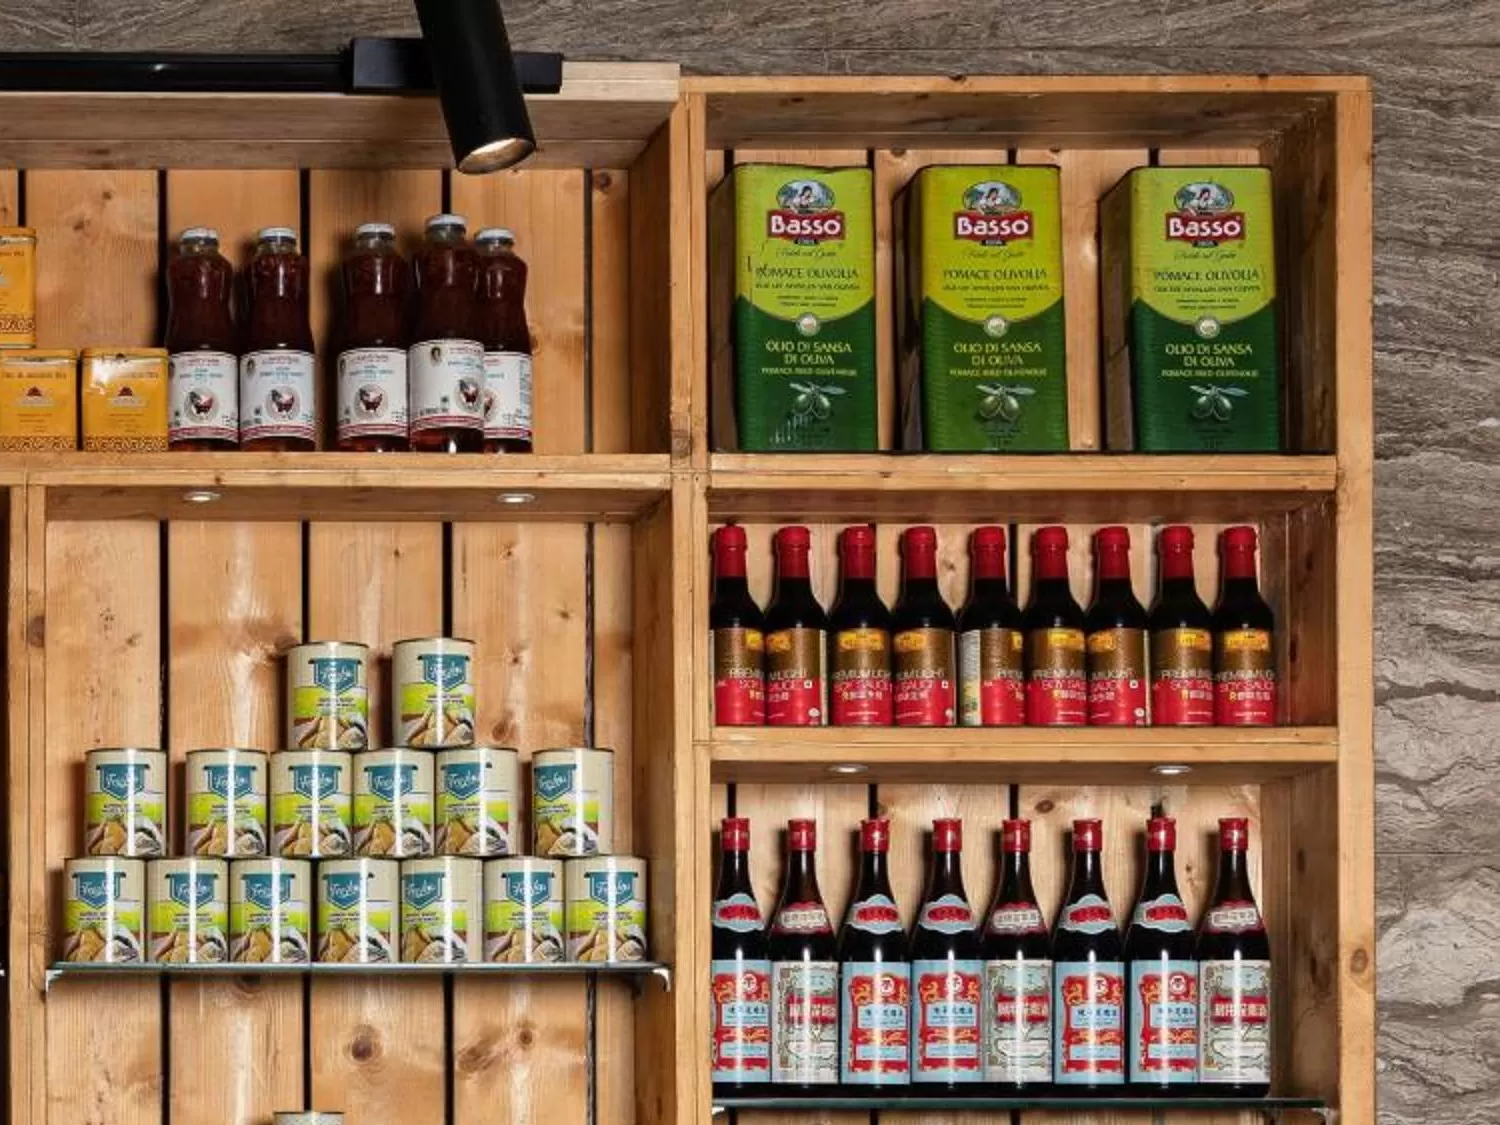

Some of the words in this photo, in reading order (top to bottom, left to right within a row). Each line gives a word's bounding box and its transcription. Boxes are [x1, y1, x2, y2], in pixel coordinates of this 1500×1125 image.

[771, 215, 841, 236] Basso
[956, 216, 1029, 236] Basso
[1169, 218, 1241, 237] Basso
[765, 341, 795, 353] OLIO
[813, 341, 853, 353] SANSA
[953, 342, 982, 353] OLIO
[1001, 341, 1042, 353] SANSA
[1165, 343, 1195, 355] OLIO
[1212, 343, 1253, 356] SANSA
[800, 353, 835, 365] OLIVA
[988, 354, 1024, 366] OLIVA
[1200, 355, 1236, 367] OLIVA
